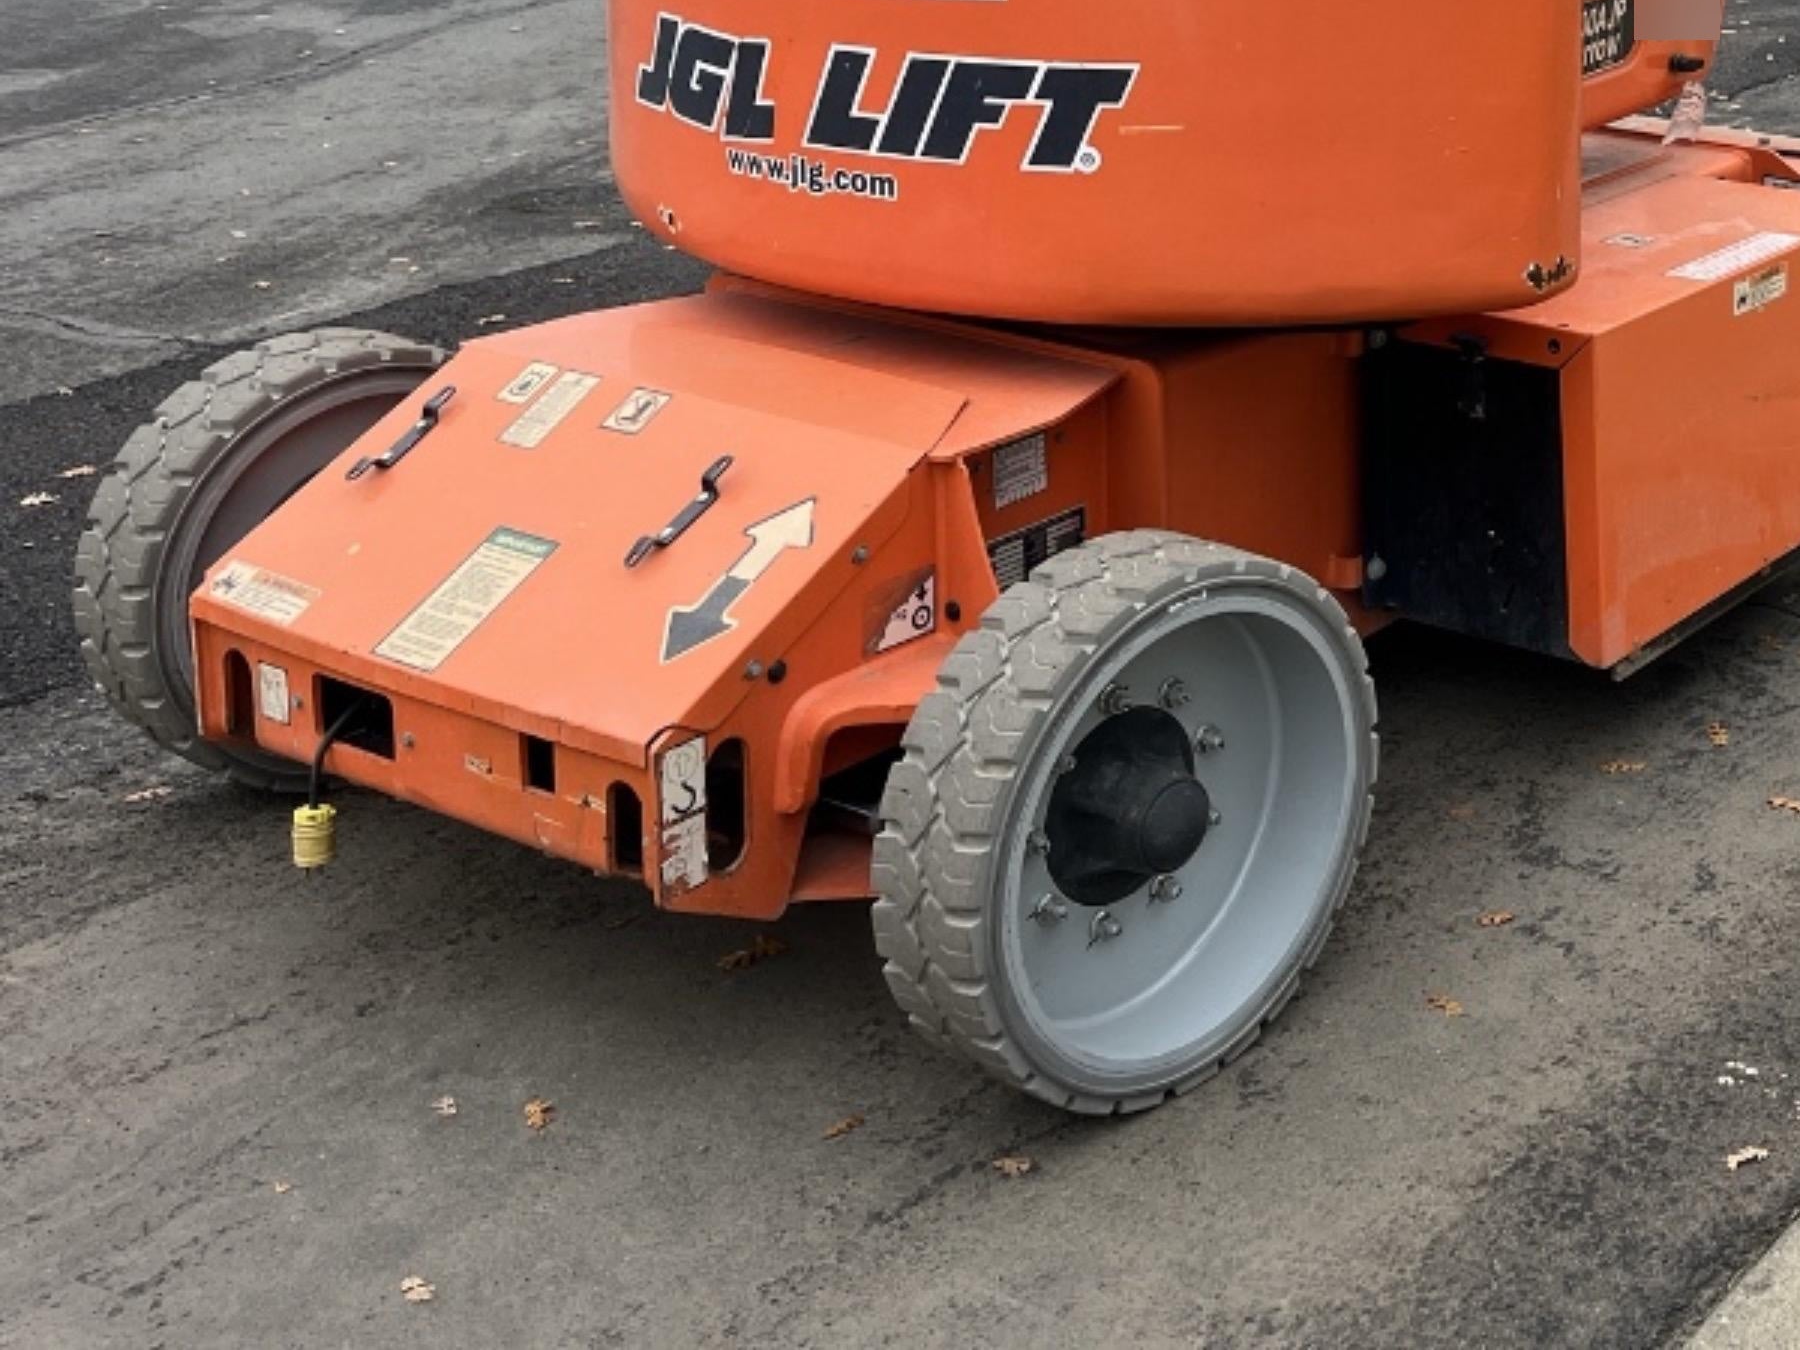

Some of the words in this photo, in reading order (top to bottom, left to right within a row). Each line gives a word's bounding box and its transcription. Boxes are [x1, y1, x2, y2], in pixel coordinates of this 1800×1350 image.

[637, 11, 775, 143] JGL
[802, 42, 1141, 172] LIFT
[727, 148, 897, 199] www.jlg.com
